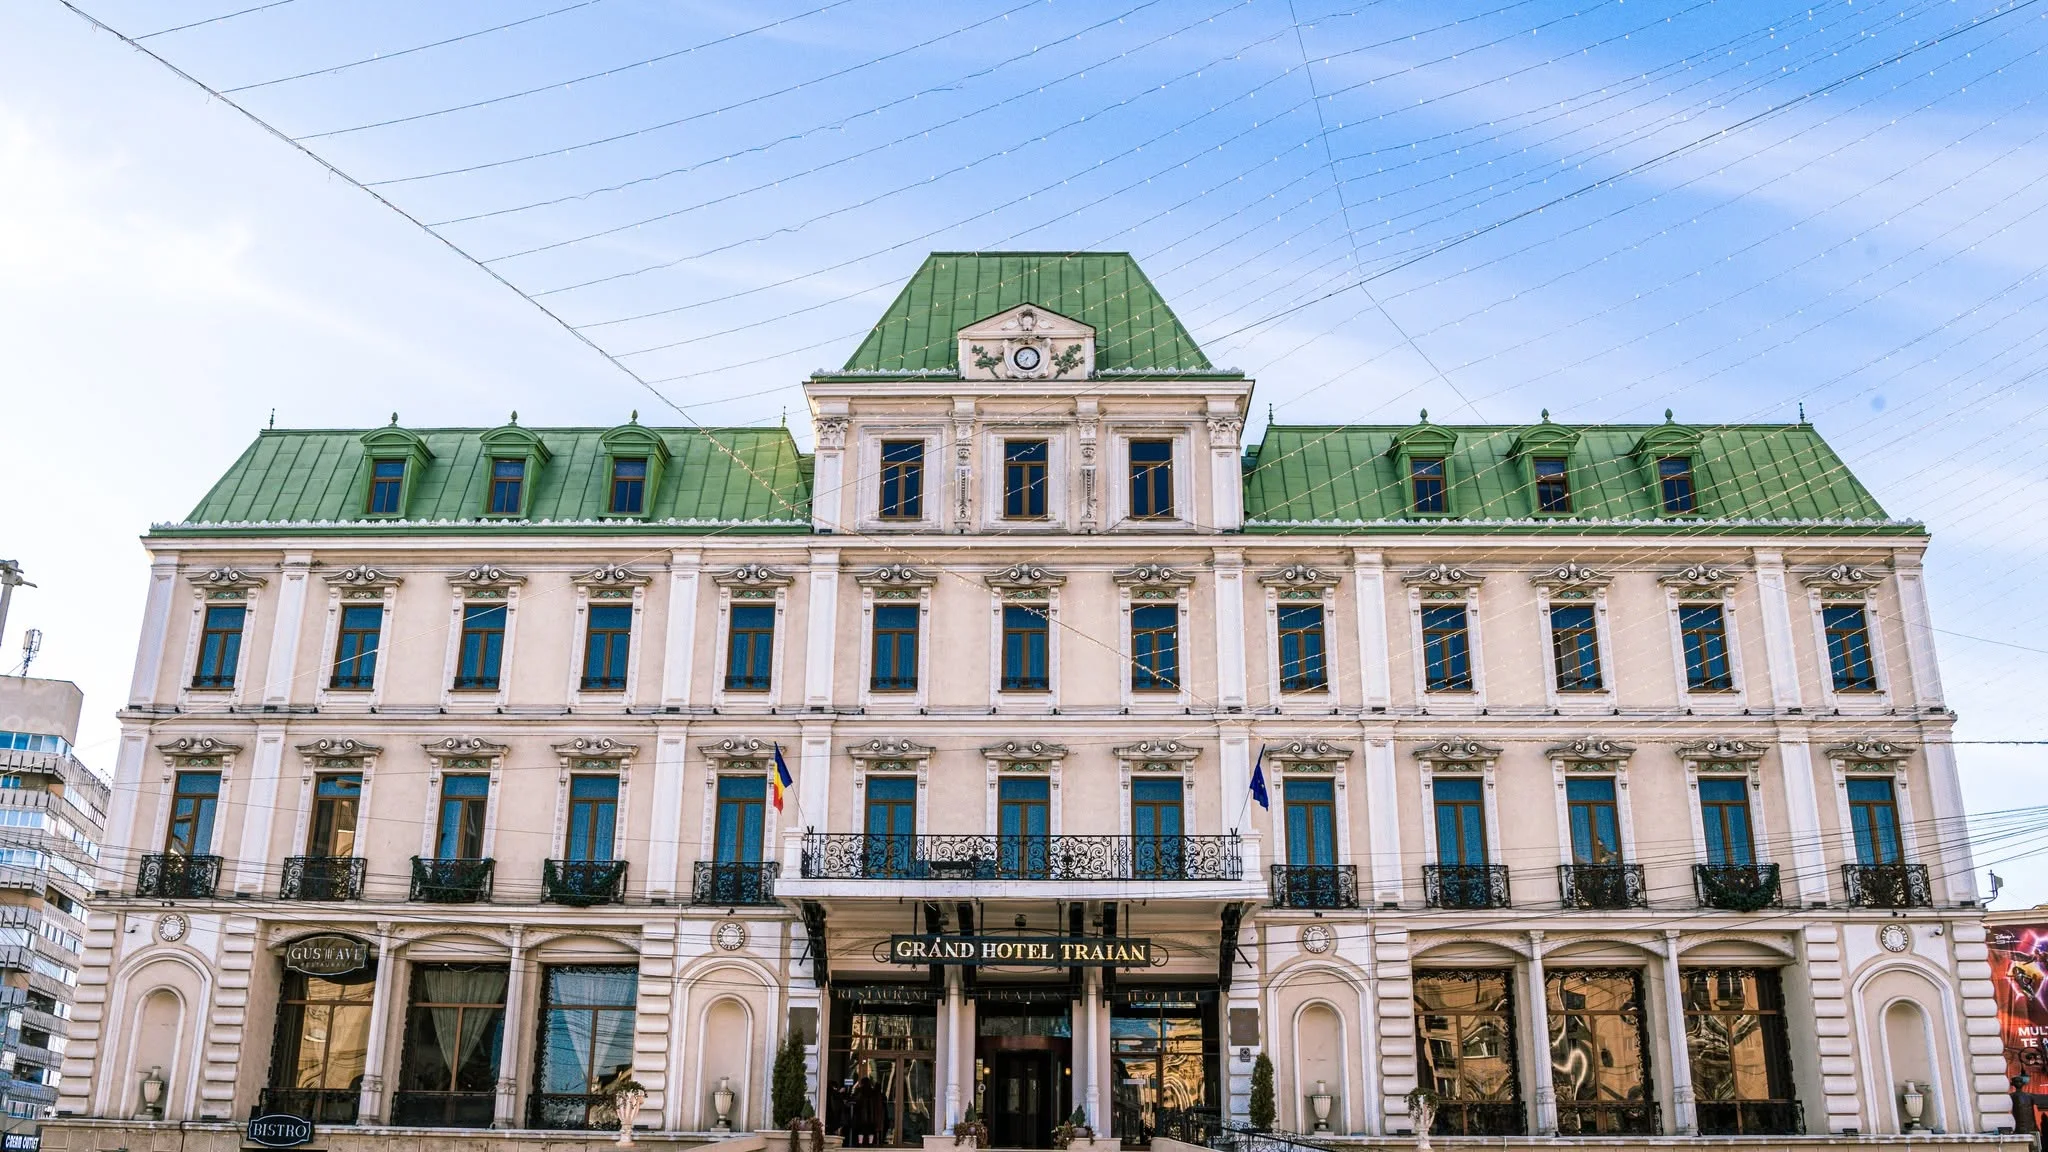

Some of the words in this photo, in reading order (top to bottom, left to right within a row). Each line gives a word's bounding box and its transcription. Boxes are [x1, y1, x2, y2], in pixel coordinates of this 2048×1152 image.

[981, 943, 1054, 960] HOTEL
[1060, 944, 1146, 960] TRAIAN
[2021, 1038, 2039, 1048] TE
[253, 1123, 307, 1137] BISTRO
[22, 1136, 40, 1150] OUTLET
